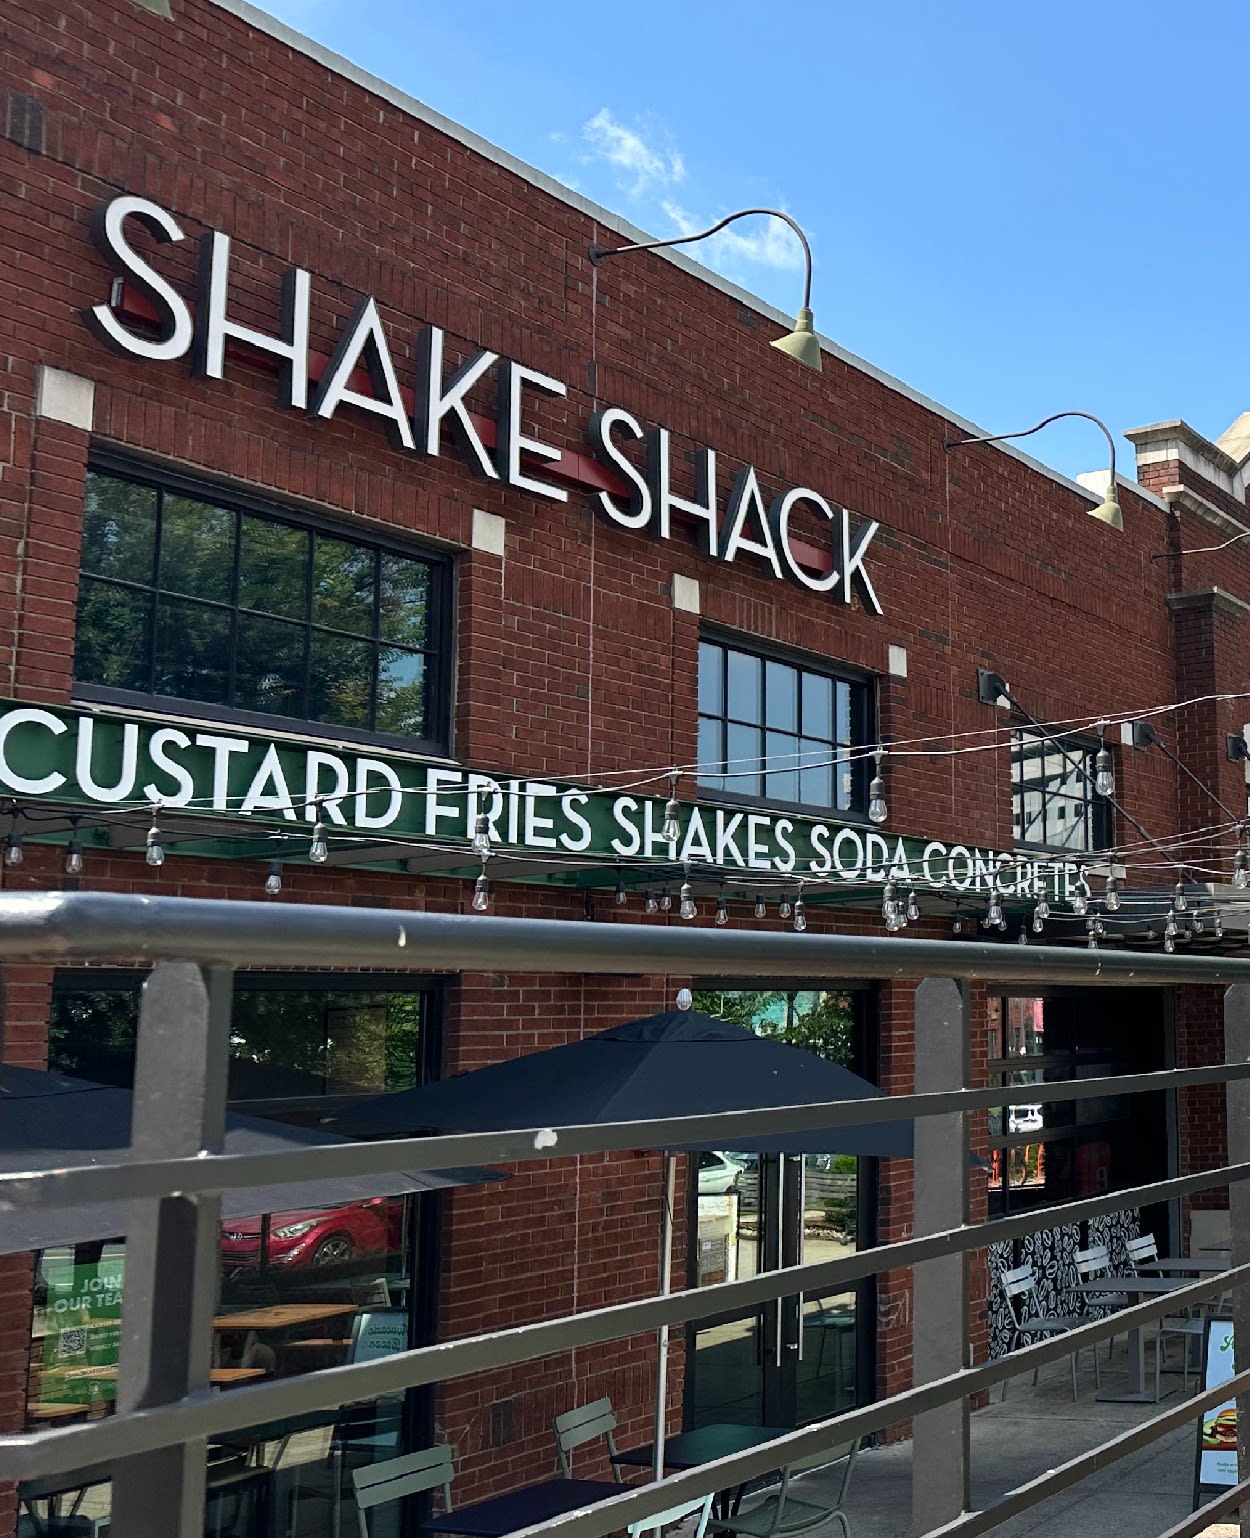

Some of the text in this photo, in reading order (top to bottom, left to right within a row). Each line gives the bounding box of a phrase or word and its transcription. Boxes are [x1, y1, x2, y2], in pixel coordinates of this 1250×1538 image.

[90, 196, 883, 616] SHAKE SHACK
[0, 708, 1091, 902] CUSTARD FRIES SHAKES SODA CONCRETES
[54, 1291, 123, 1313] OUR TEA
[80, 1273, 122, 1293] JOIN
